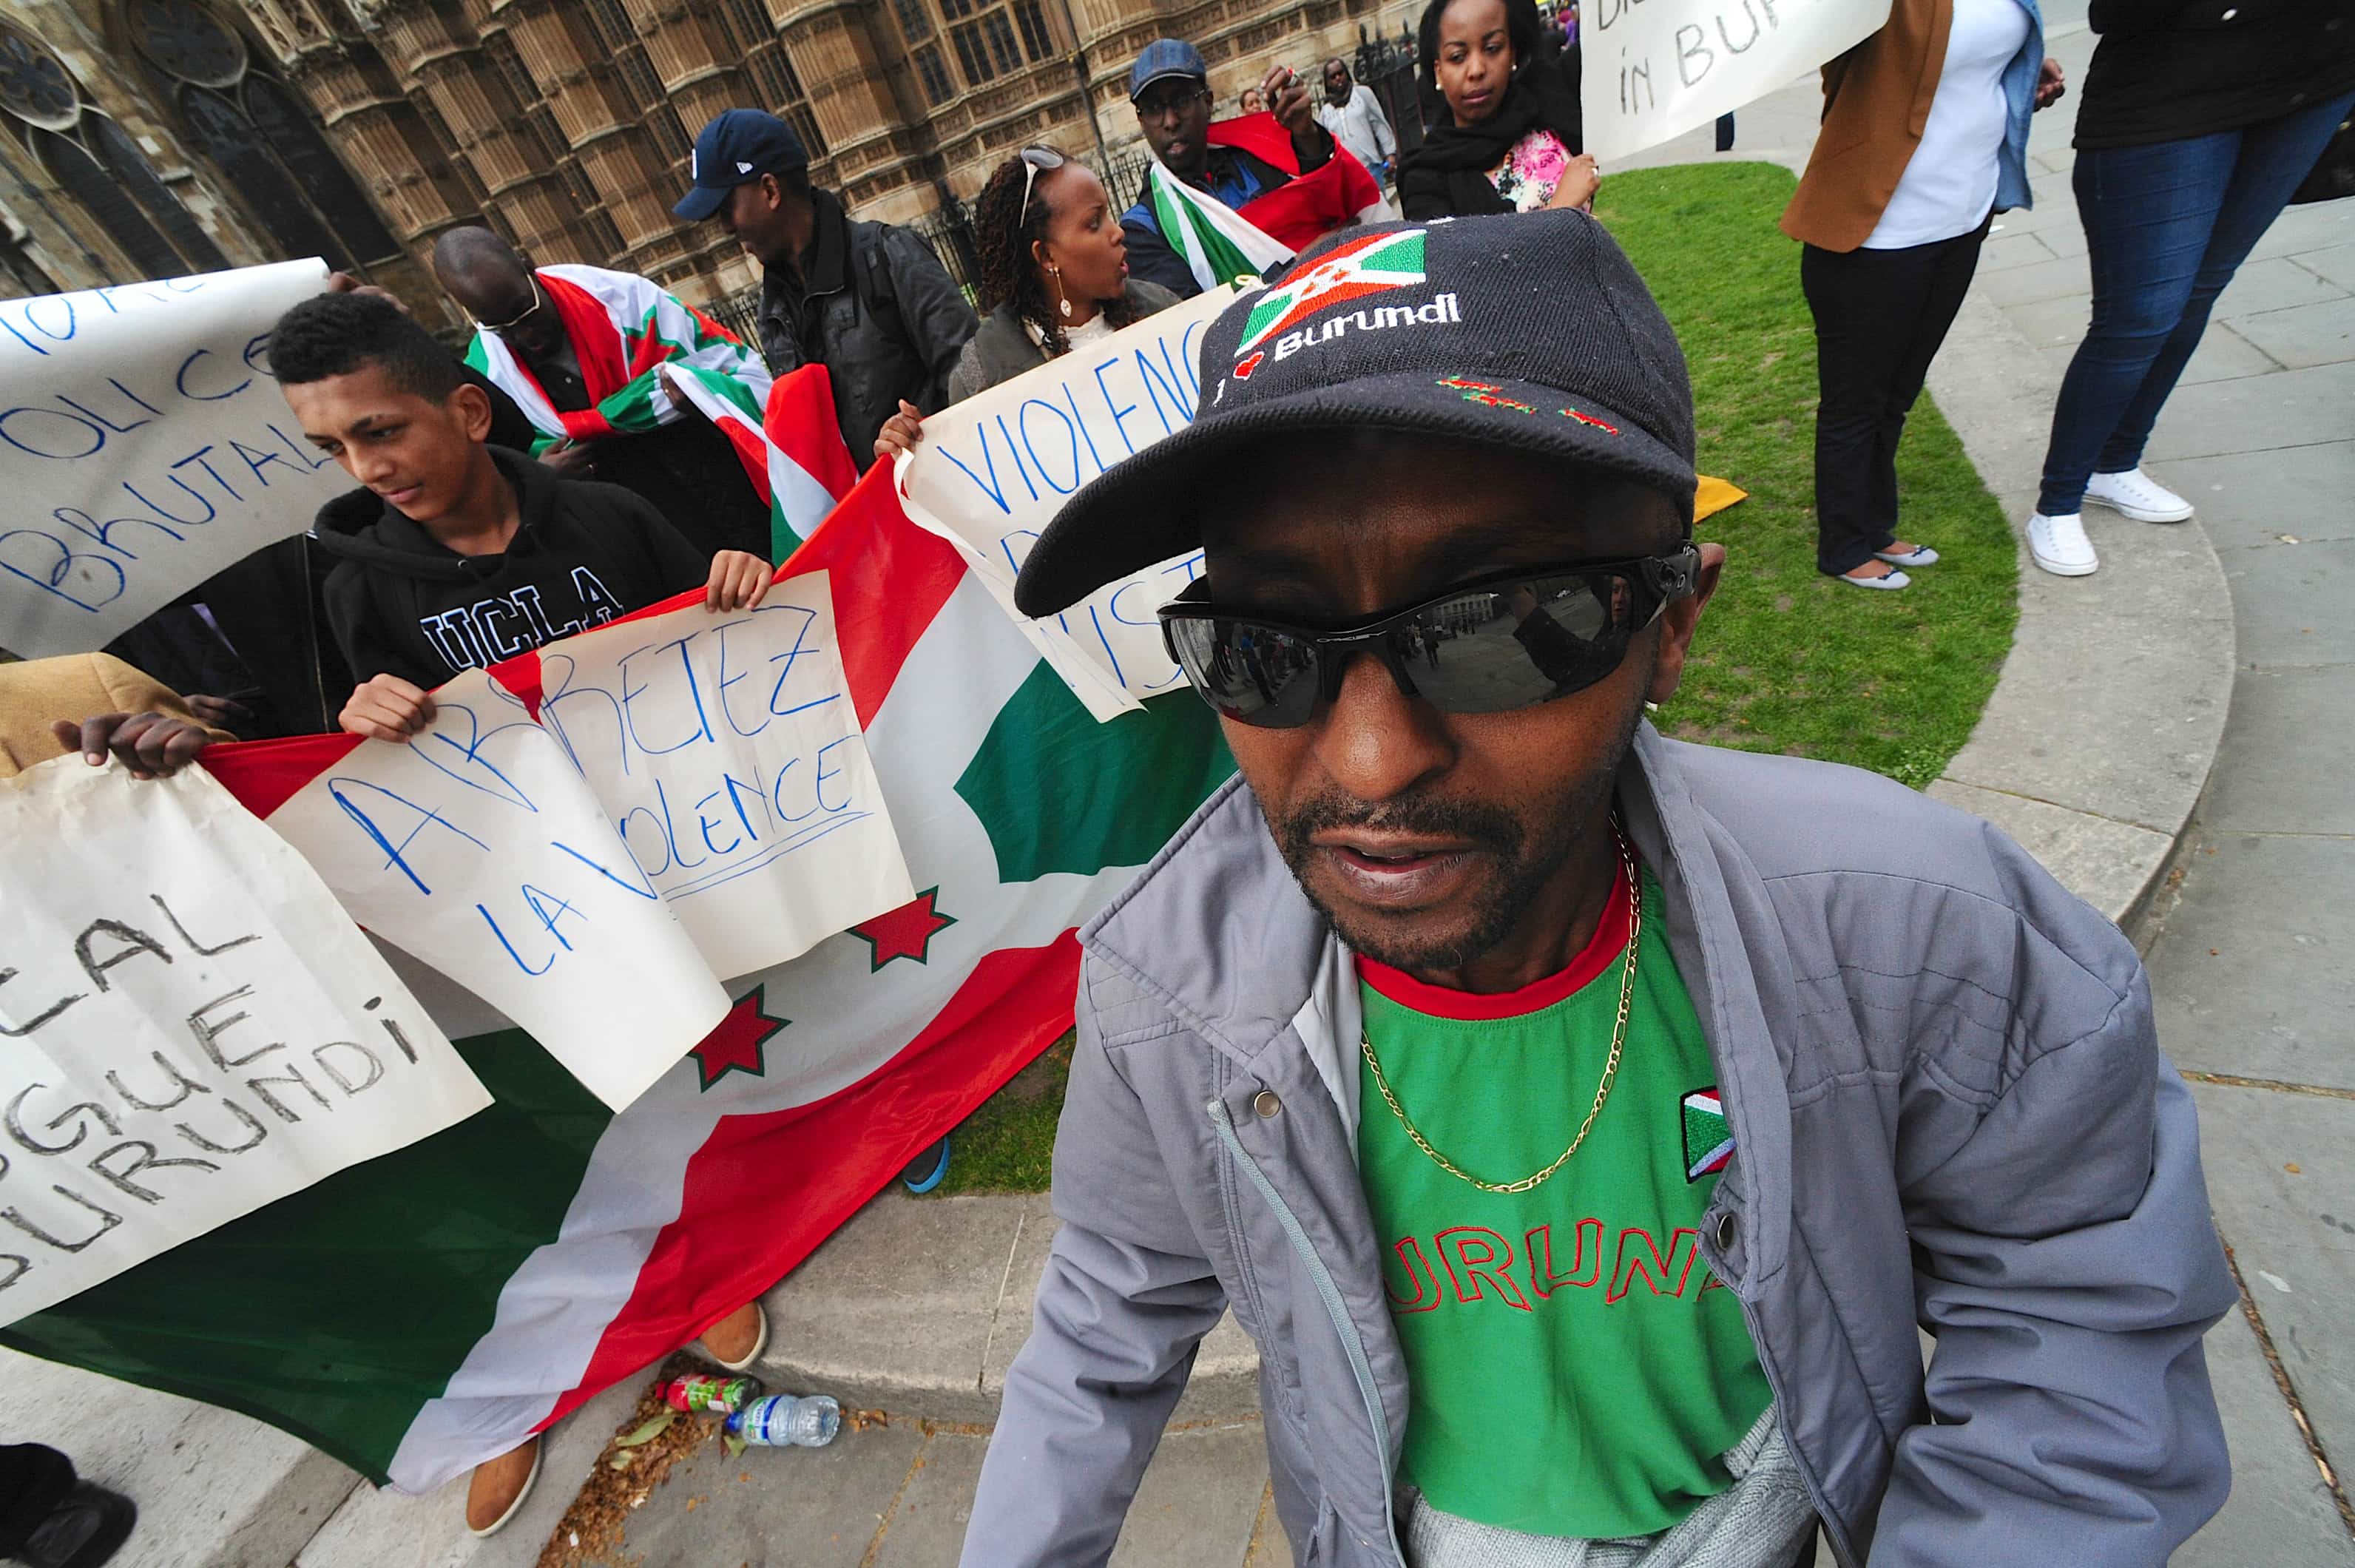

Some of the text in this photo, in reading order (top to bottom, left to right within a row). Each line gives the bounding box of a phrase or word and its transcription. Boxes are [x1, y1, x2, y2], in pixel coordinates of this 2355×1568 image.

[1676, 0, 1779, 89] BU
[419, 566, 626, 675] UCLA
[476, 883, 589, 977] LA
